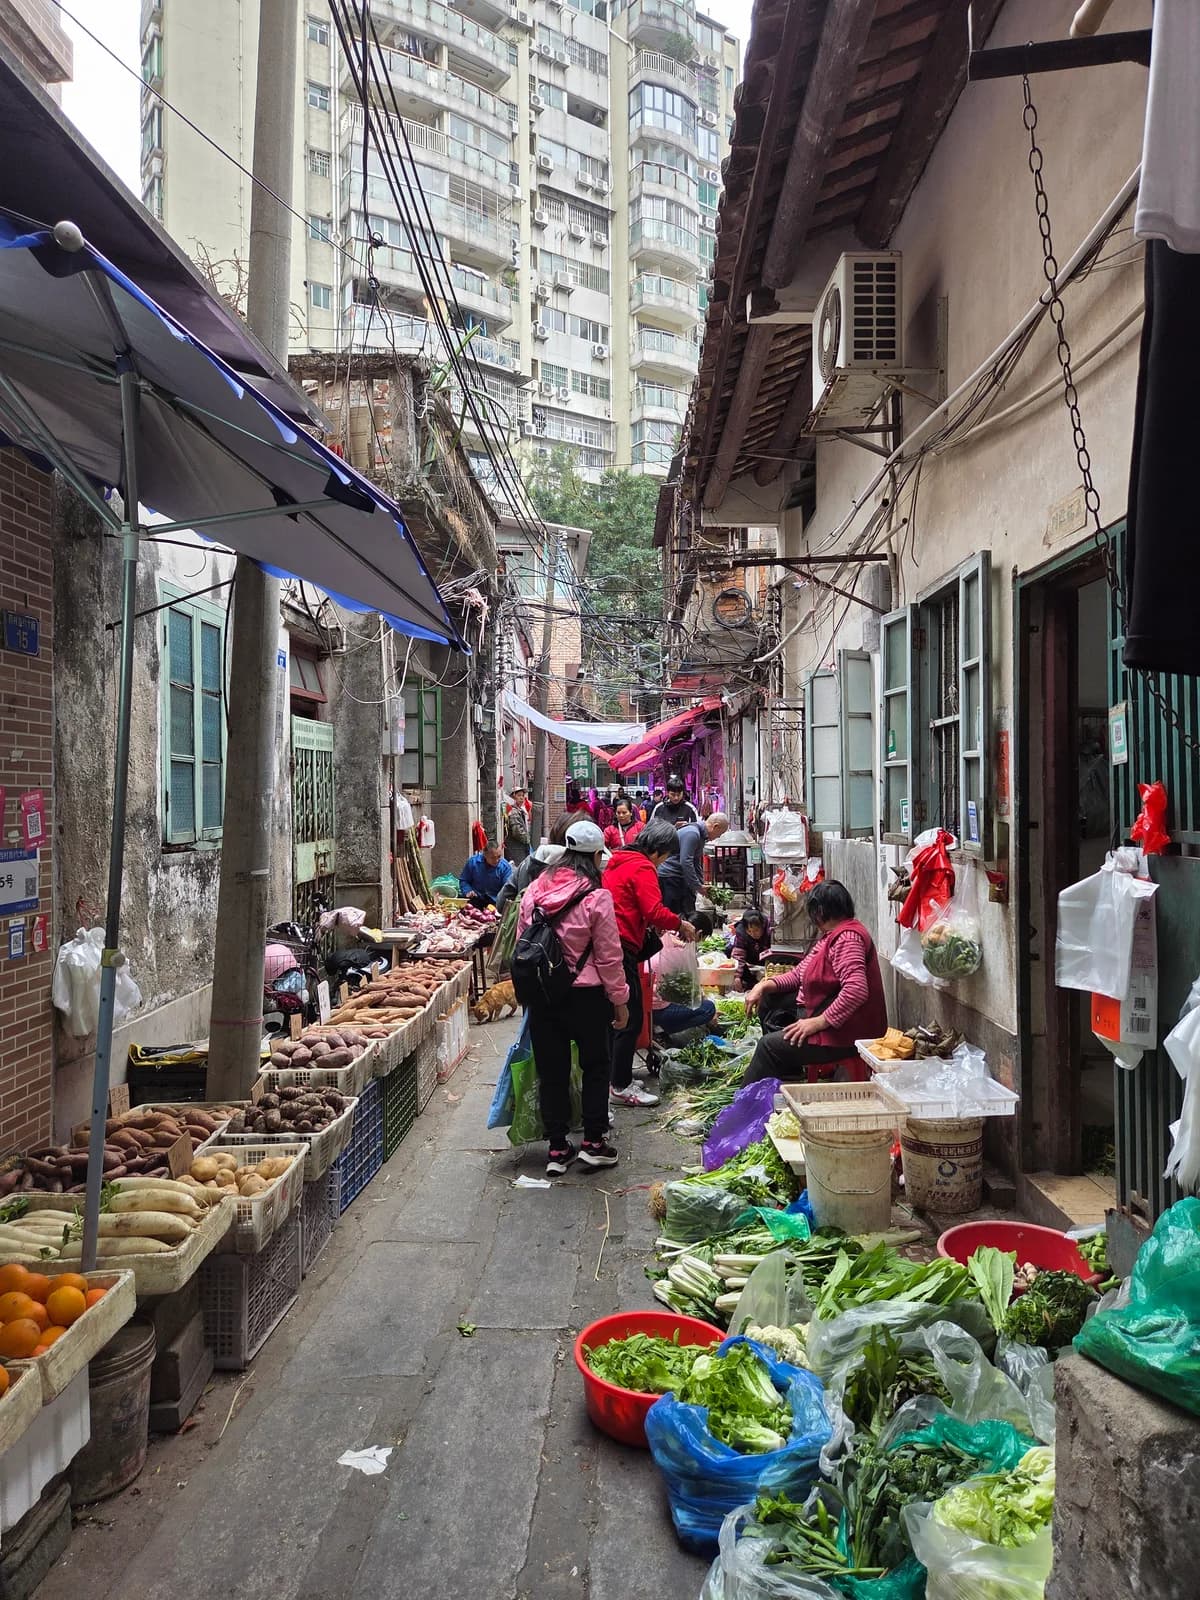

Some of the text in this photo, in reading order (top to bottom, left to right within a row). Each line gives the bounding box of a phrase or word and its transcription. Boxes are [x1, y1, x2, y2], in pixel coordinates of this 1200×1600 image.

[17, 629, 28, 649] 15
[572, 744, 588, 779] 土猪肉
